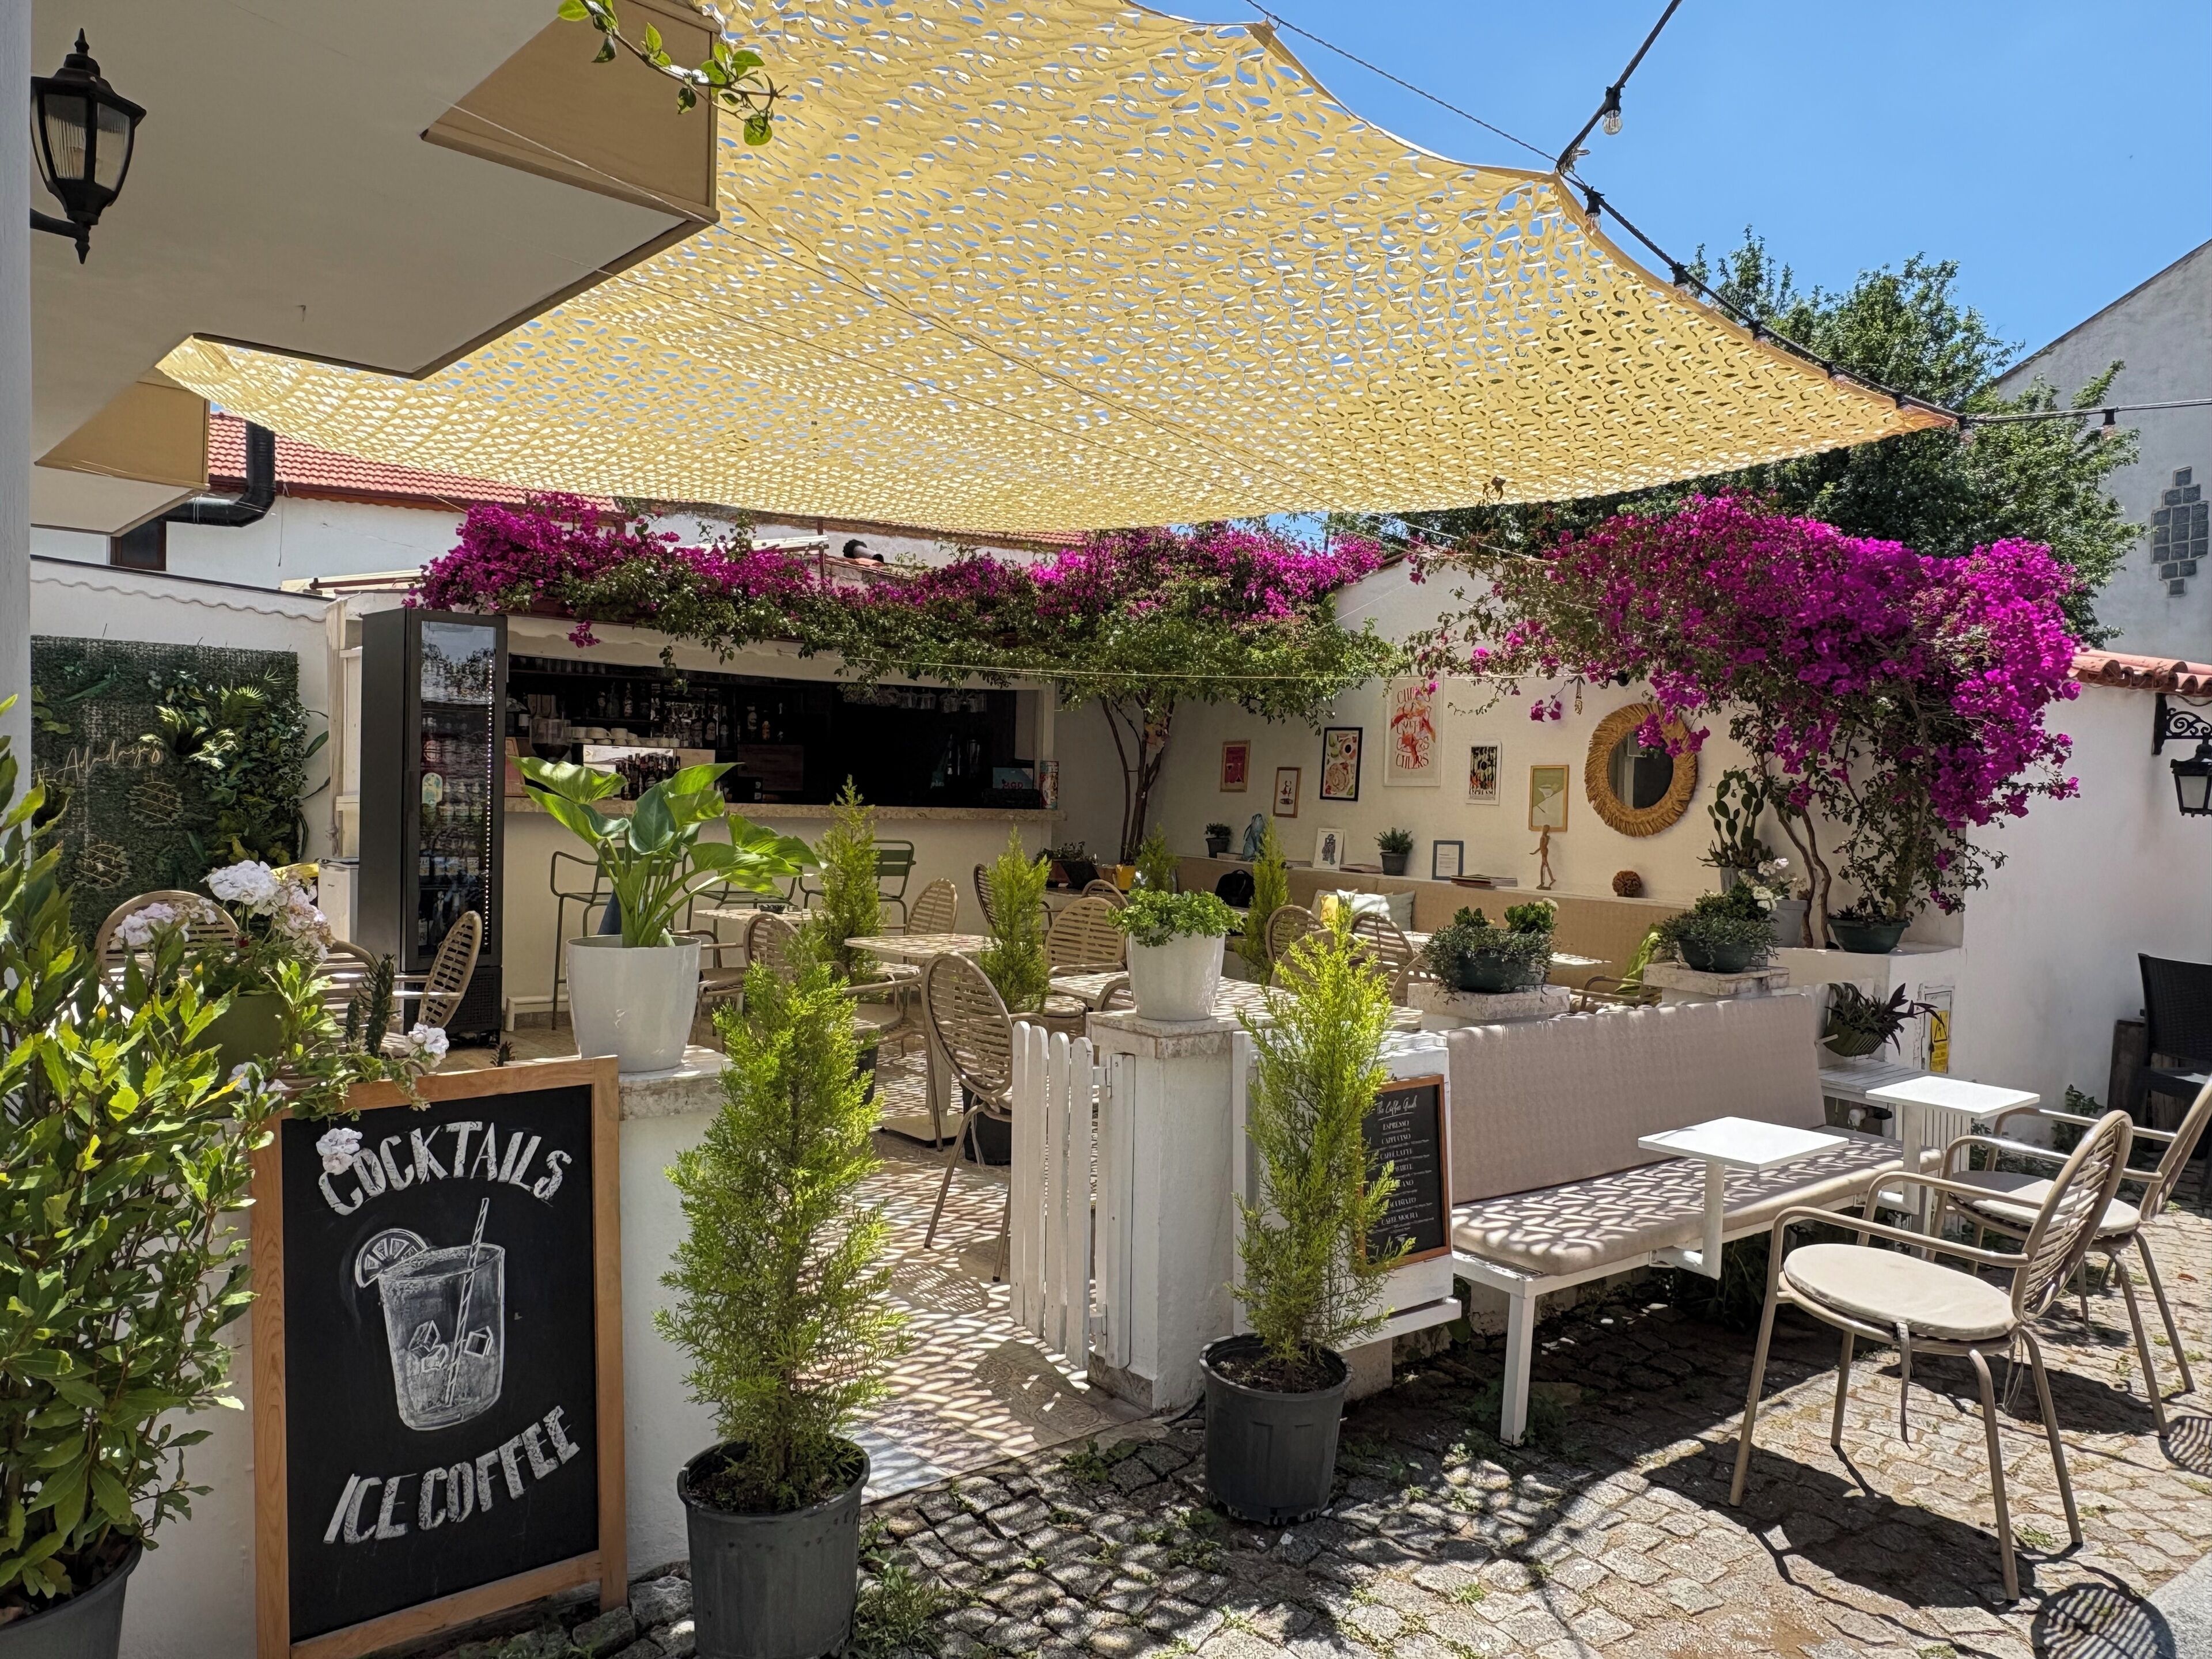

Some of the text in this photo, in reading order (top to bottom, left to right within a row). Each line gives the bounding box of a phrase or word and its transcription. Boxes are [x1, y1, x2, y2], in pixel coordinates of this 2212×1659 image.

[319, 1120, 573, 1215] COCKTAILS
[323, 1405, 581, 1545] ICE COFFEE
